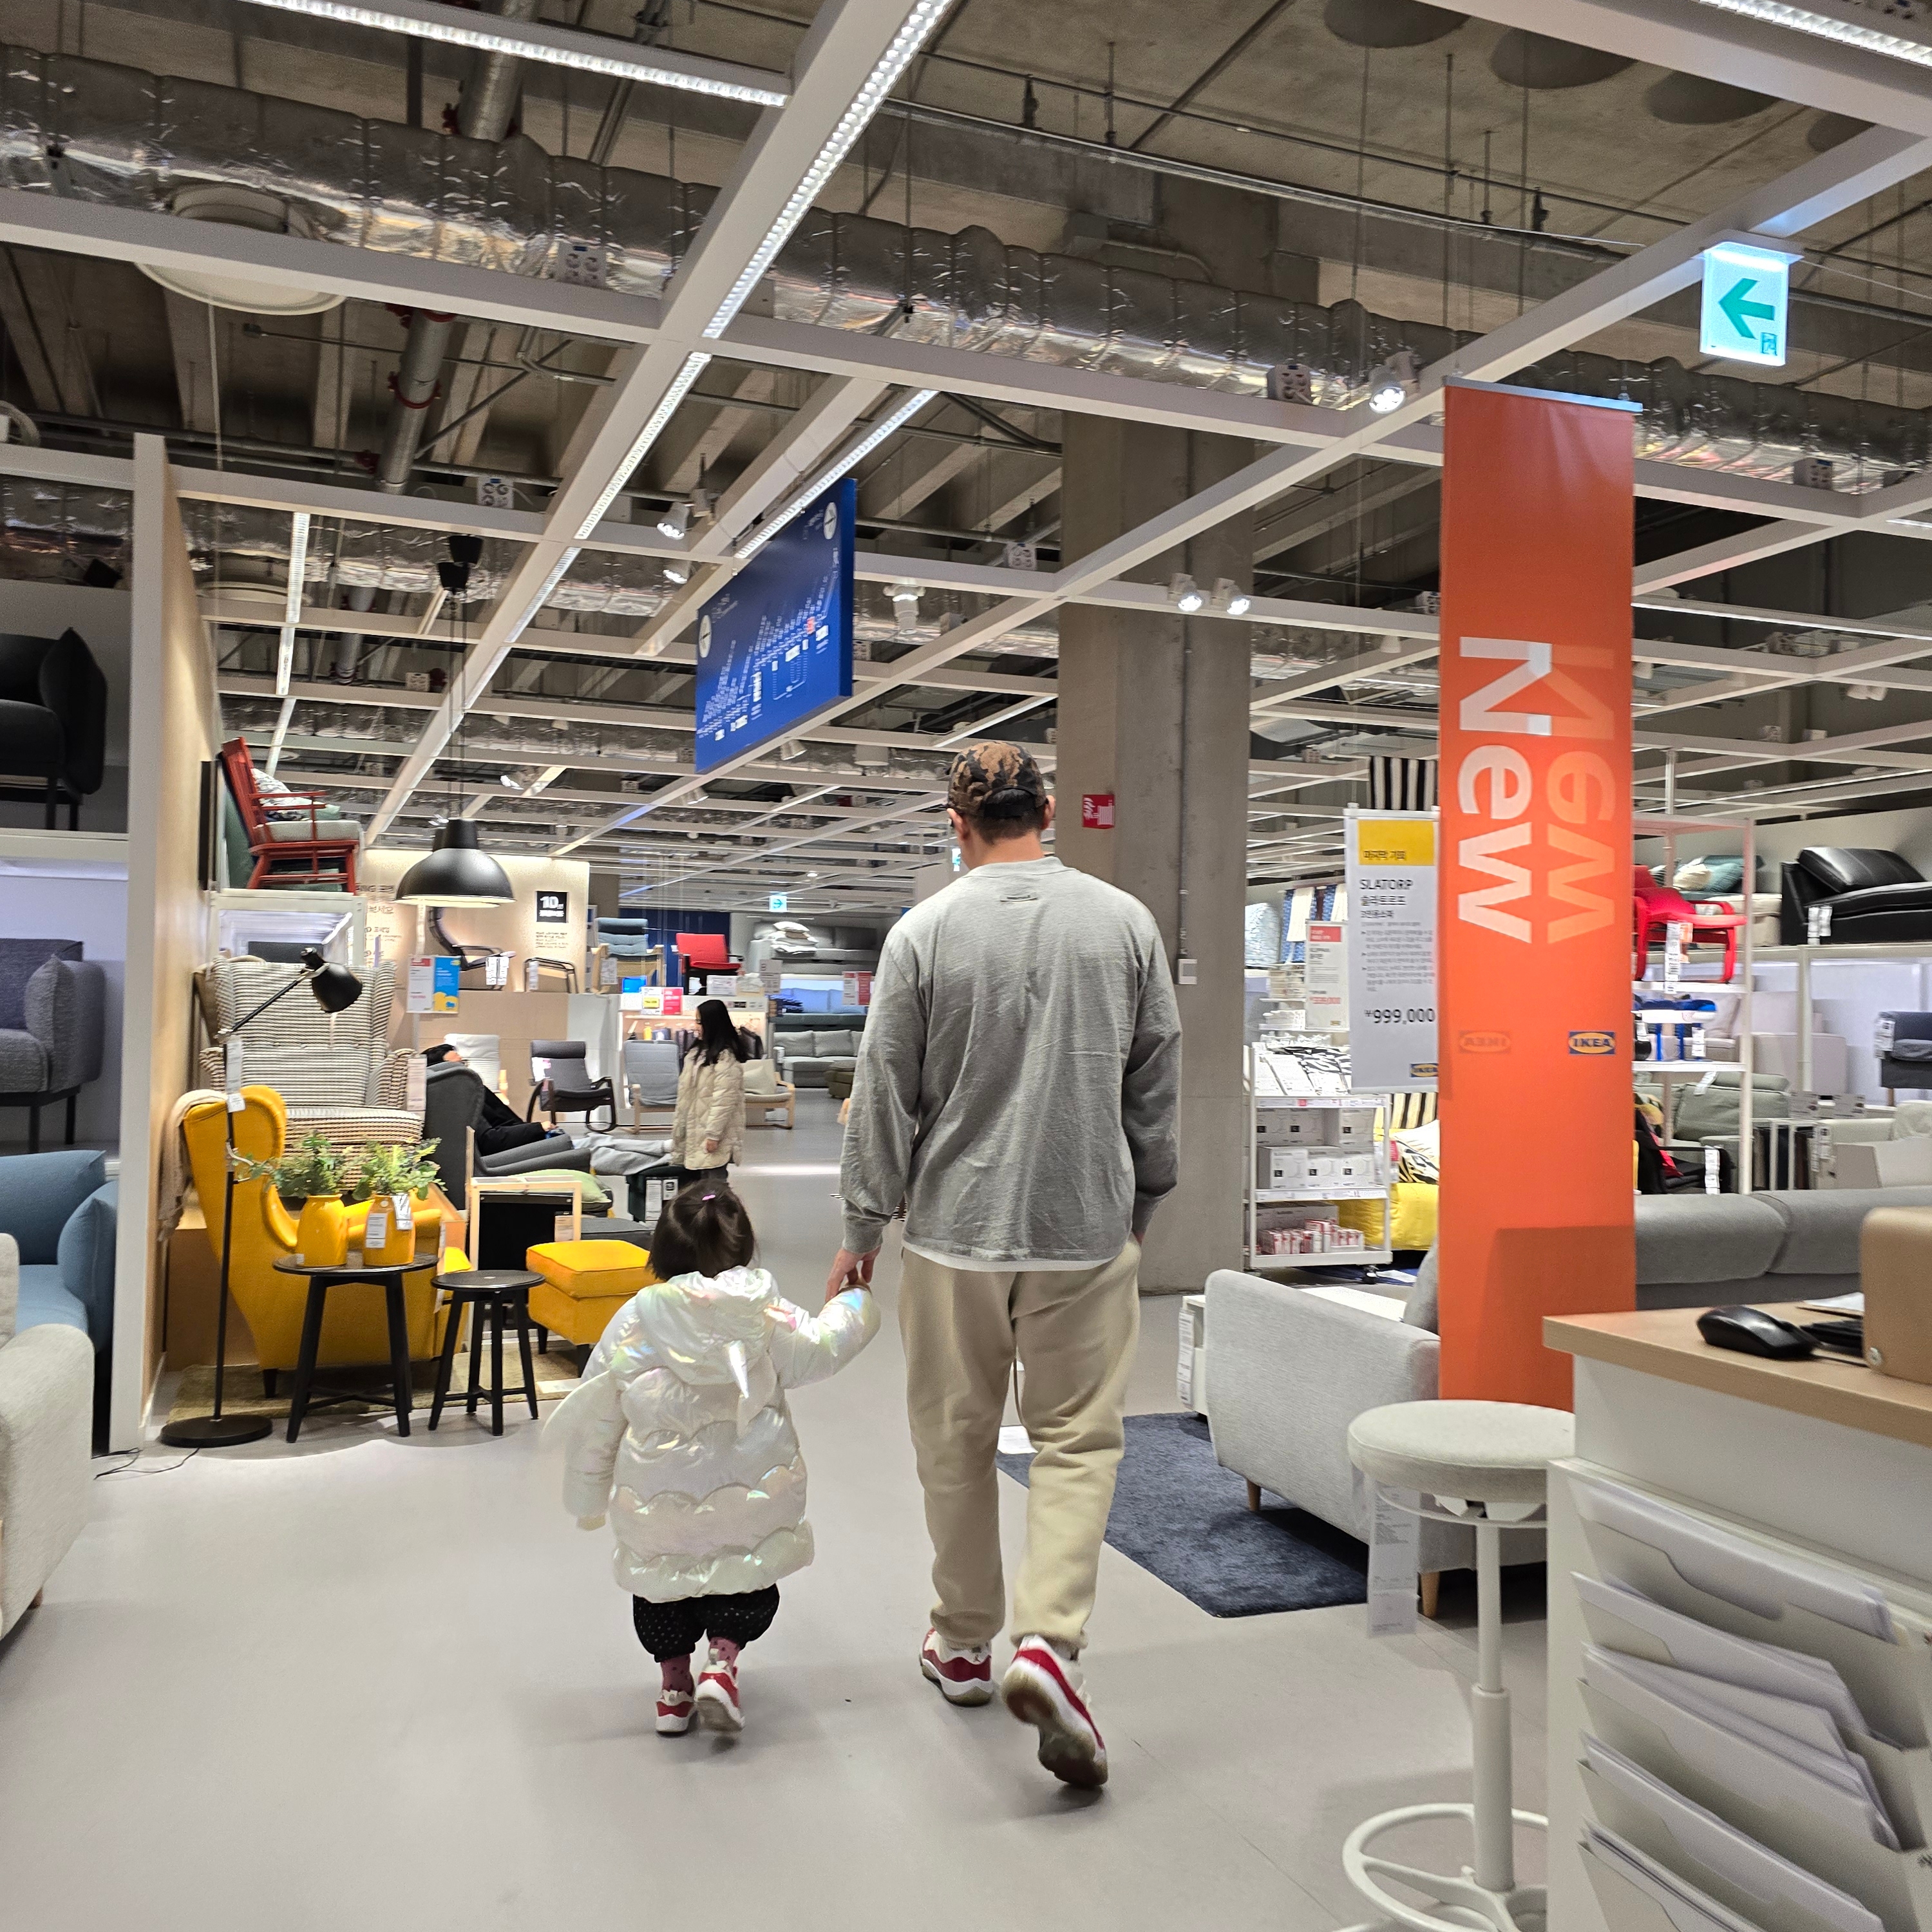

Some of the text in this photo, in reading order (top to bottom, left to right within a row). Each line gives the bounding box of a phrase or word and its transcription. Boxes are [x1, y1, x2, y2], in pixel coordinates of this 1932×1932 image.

[1459, 636, 1552, 944] New
[1359, 879, 1414, 889] SLATORP
[1573, 1038, 1612, 1048] IKEA
